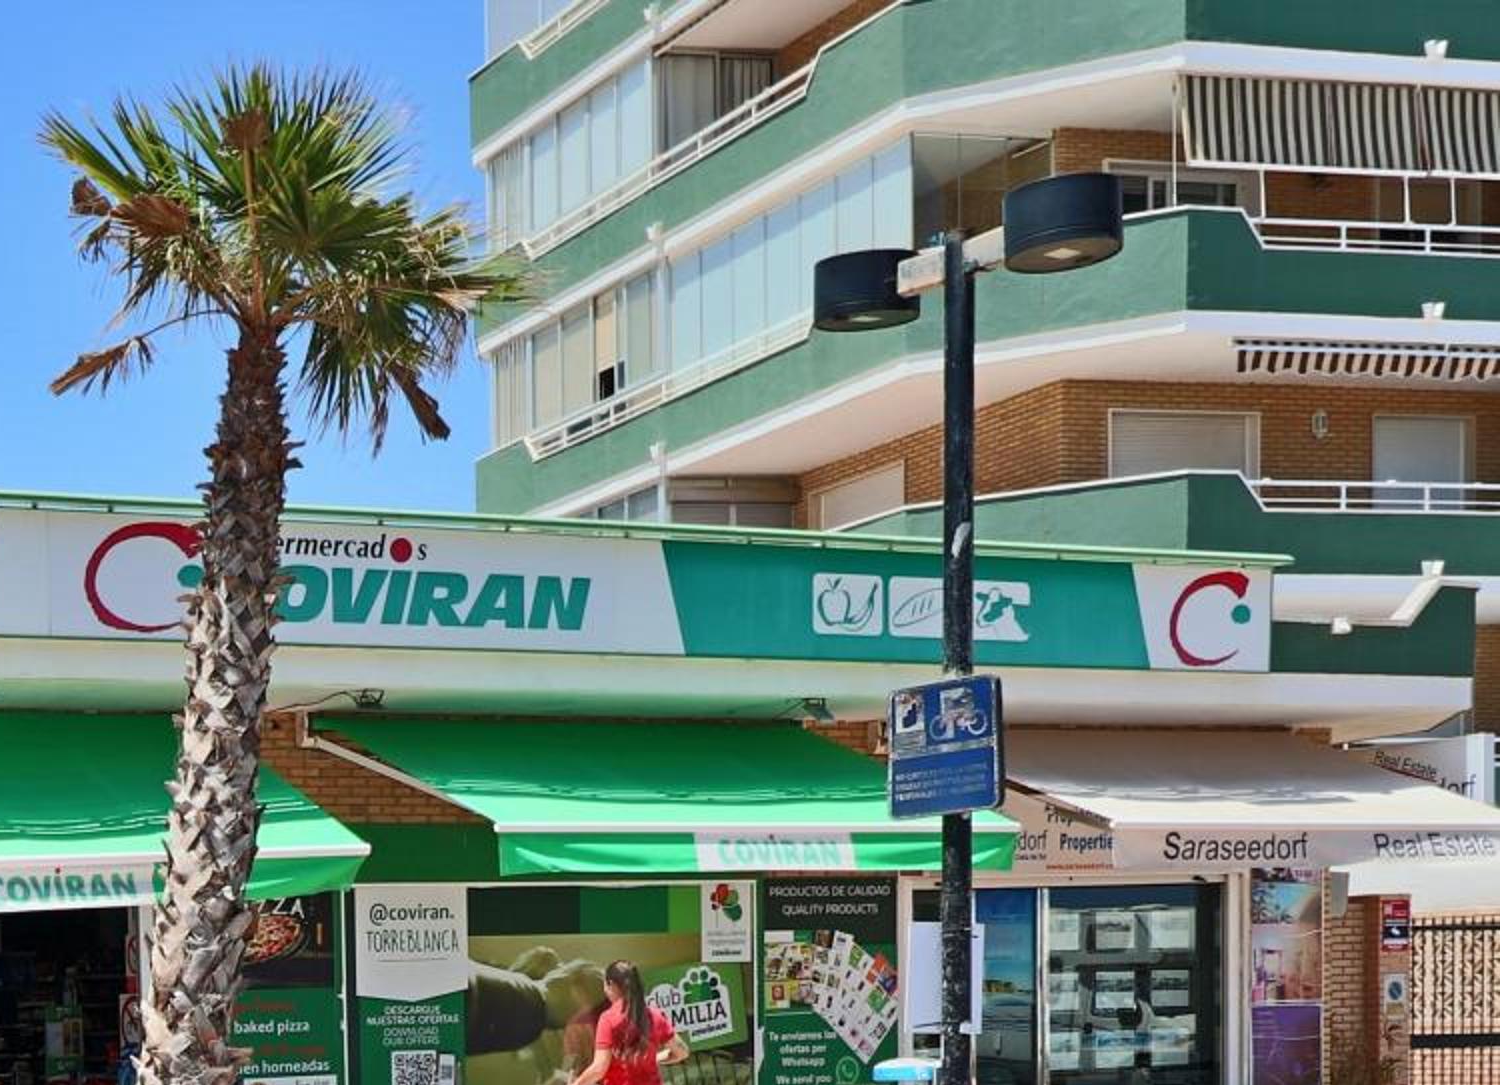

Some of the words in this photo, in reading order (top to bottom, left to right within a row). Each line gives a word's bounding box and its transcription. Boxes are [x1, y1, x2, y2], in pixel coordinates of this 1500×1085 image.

[276, 533, 428, 563] ermercados
[270, 564, 591, 631] OVIRAN
[1374, 751, 1401, 767] Real
[1402, 756, 1438, 778] Estate
[718, 834, 842, 865] COVIRAN
[1060, 832, 1113, 854] Propertie
[1163, 831, 1309, 861] Saraseedorf
[1373, 832, 1424, 858] Real
[1427, 832, 1497, 857] Estate
[769, 885, 831, 897] PRODUCTOS
[831, 885, 845, 896] DE
[847, 884, 891, 896] CALIDAD
[782, 904, 824, 916] QUALITY
[825, 903, 879, 915] PRODUCTS
[366, 928, 460, 953] TORREBLANCA
[366, 1015, 416, 1026] NUESTRAS
[417, 1014, 460, 1025] OFERTAS
[384, 1005, 441, 1015] DESCARGUE
[671, 1000, 727, 1028] MILIA
[233, 1019, 274, 1035] baked
[277, 1019, 310, 1037] pizza
[384, 1026, 440, 1037] DOWNLOAD
[769, 1031, 779, 1041] Te
[261, 1058, 331, 1075] horneadas
[776, 1075, 791, 1085] We
[792, 1074, 813, 1085] send
[815, 1075, 833, 1085] you
